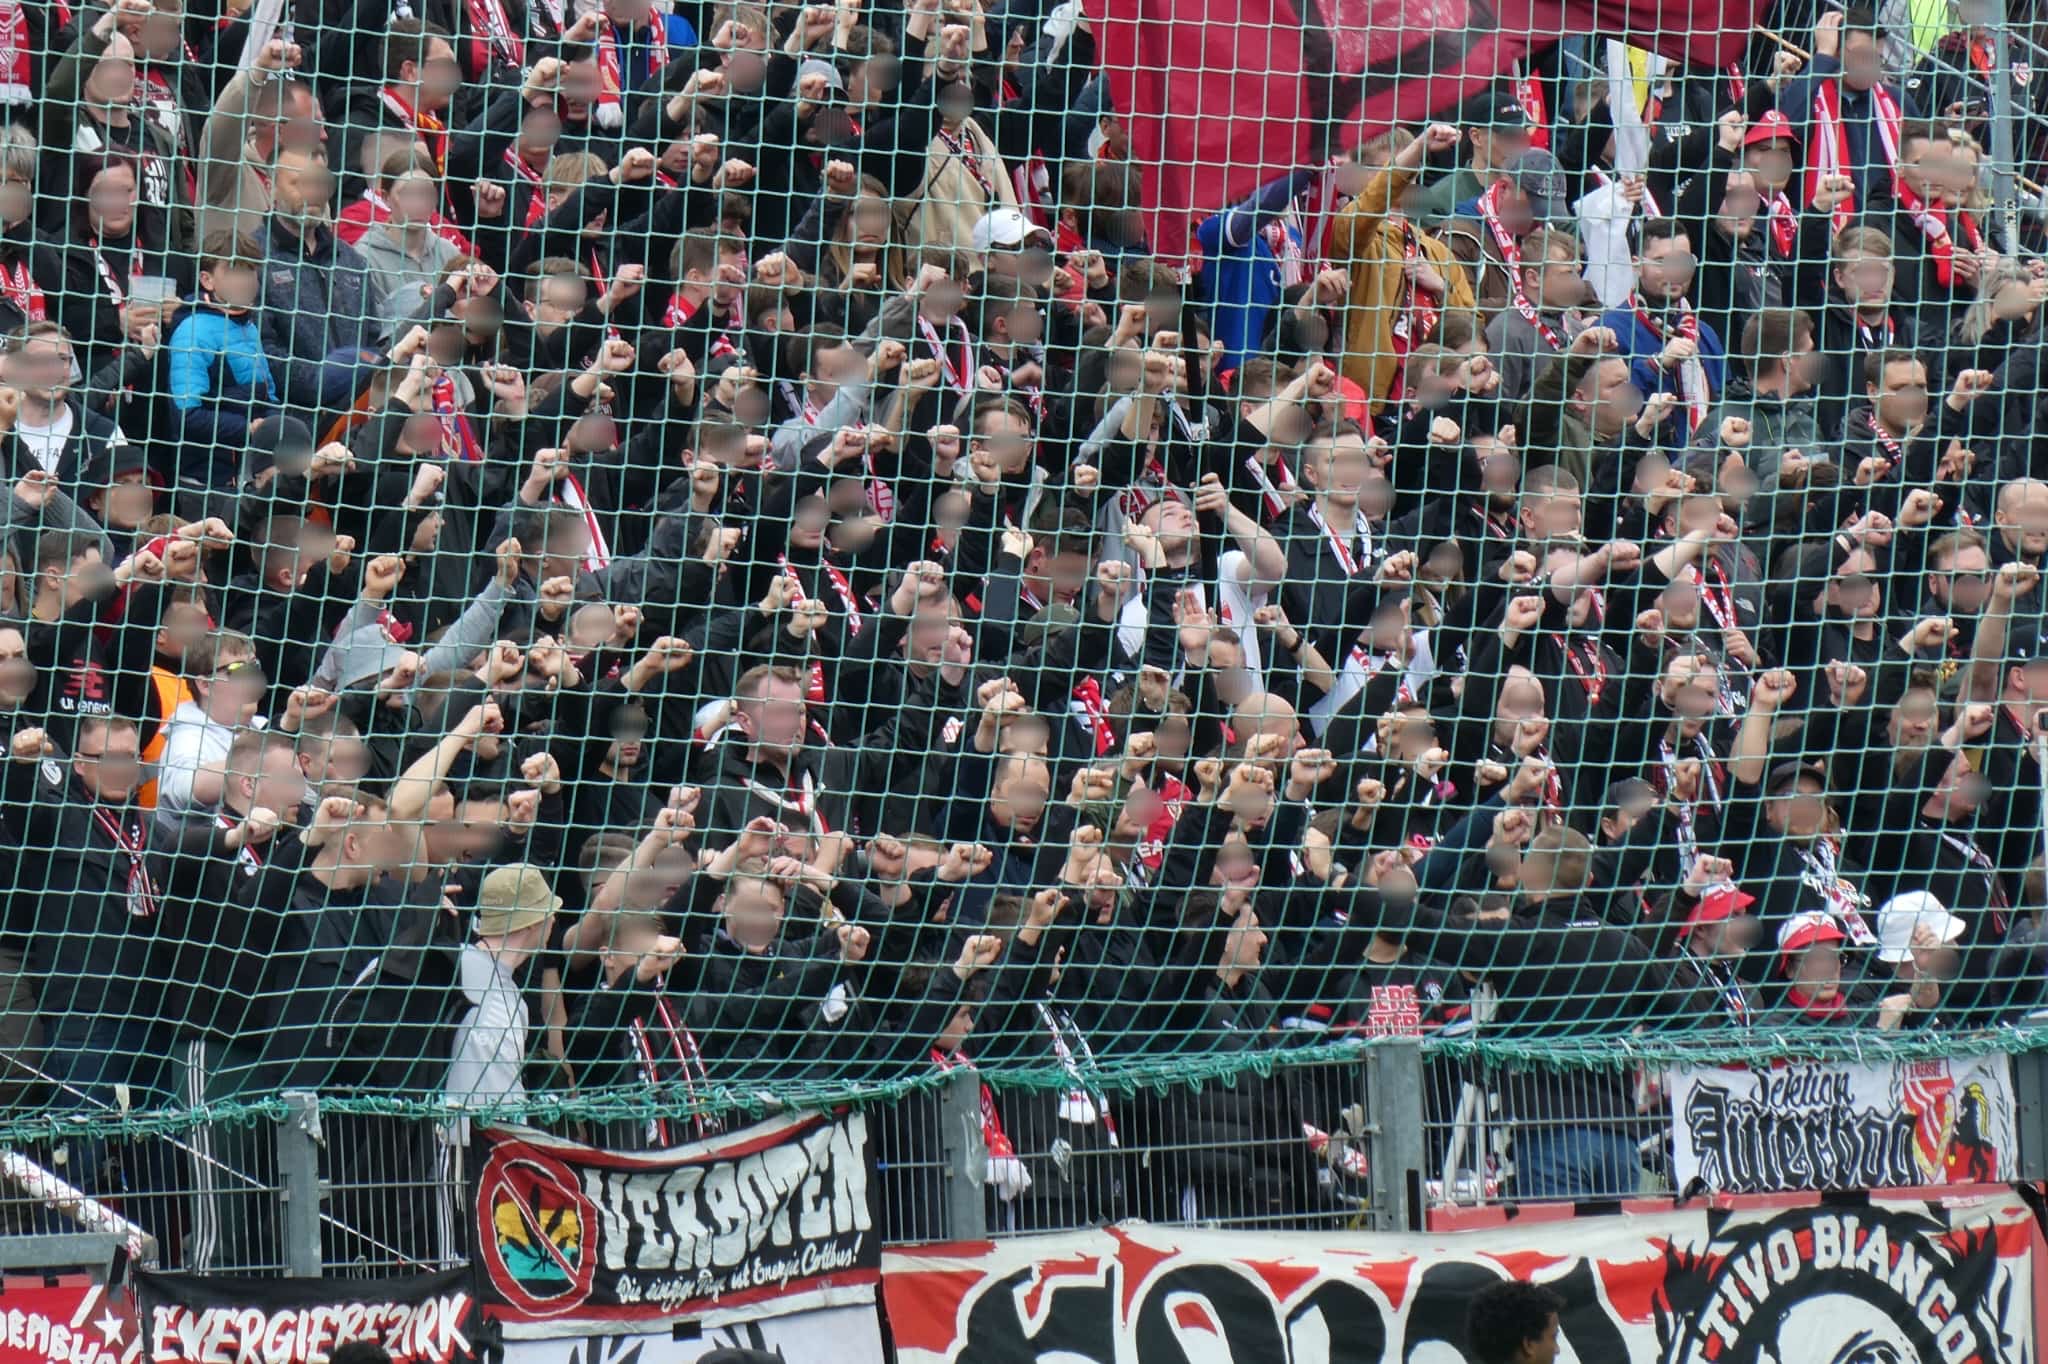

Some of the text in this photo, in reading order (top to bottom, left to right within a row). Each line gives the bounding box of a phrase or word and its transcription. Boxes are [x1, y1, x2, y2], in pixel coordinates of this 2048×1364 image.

[583, 1111, 872, 1271] VERBOTEN
[753, 1250, 800, 1291] Energie
[801, 1232, 863, 1276] Cottbus!
